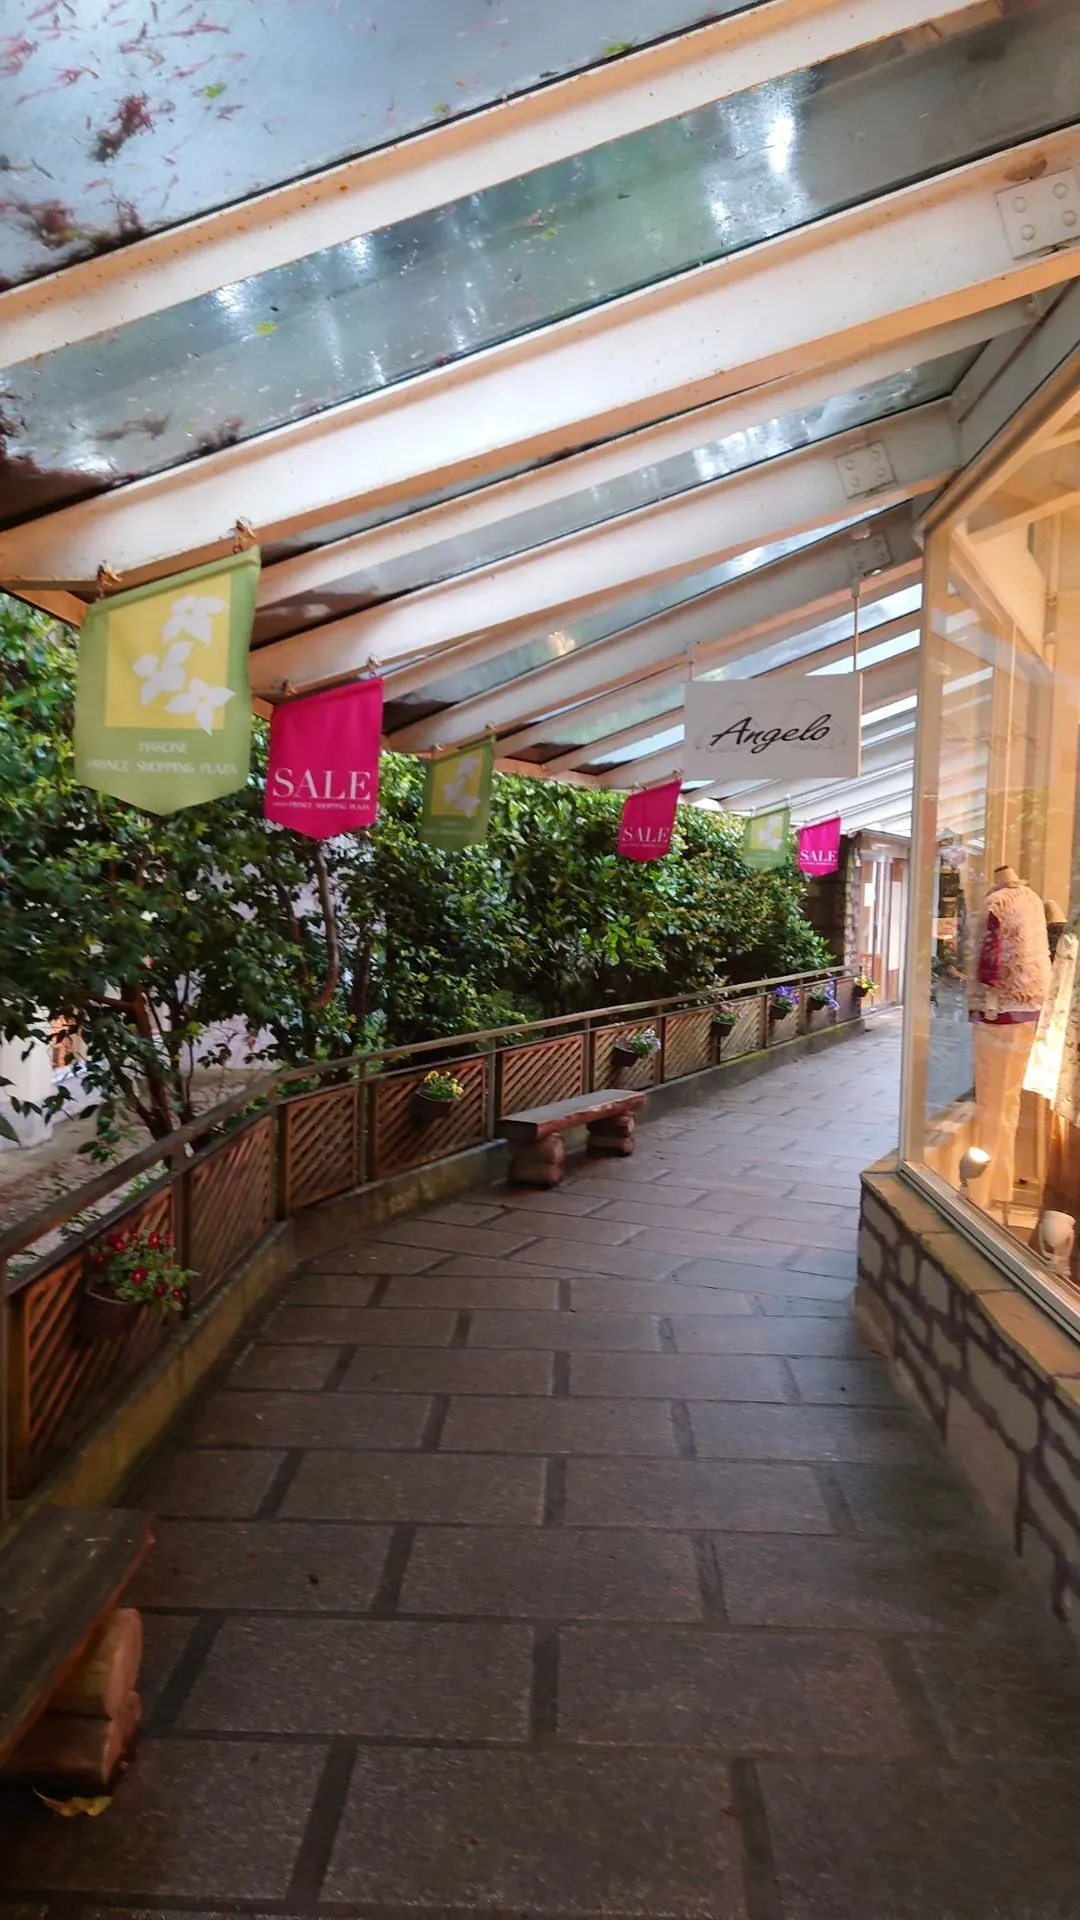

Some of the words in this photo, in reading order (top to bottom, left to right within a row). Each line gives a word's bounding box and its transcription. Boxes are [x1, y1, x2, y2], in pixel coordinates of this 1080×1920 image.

[710, 713, 832, 754] Angelo
[136, 760, 196, 774] SHOPPING
[200, 762, 238, 775] PLAZA
[272, 768, 371, 800] SALE
[622, 826, 670, 843] SALE
[800, 849, 837, 862] SALE
